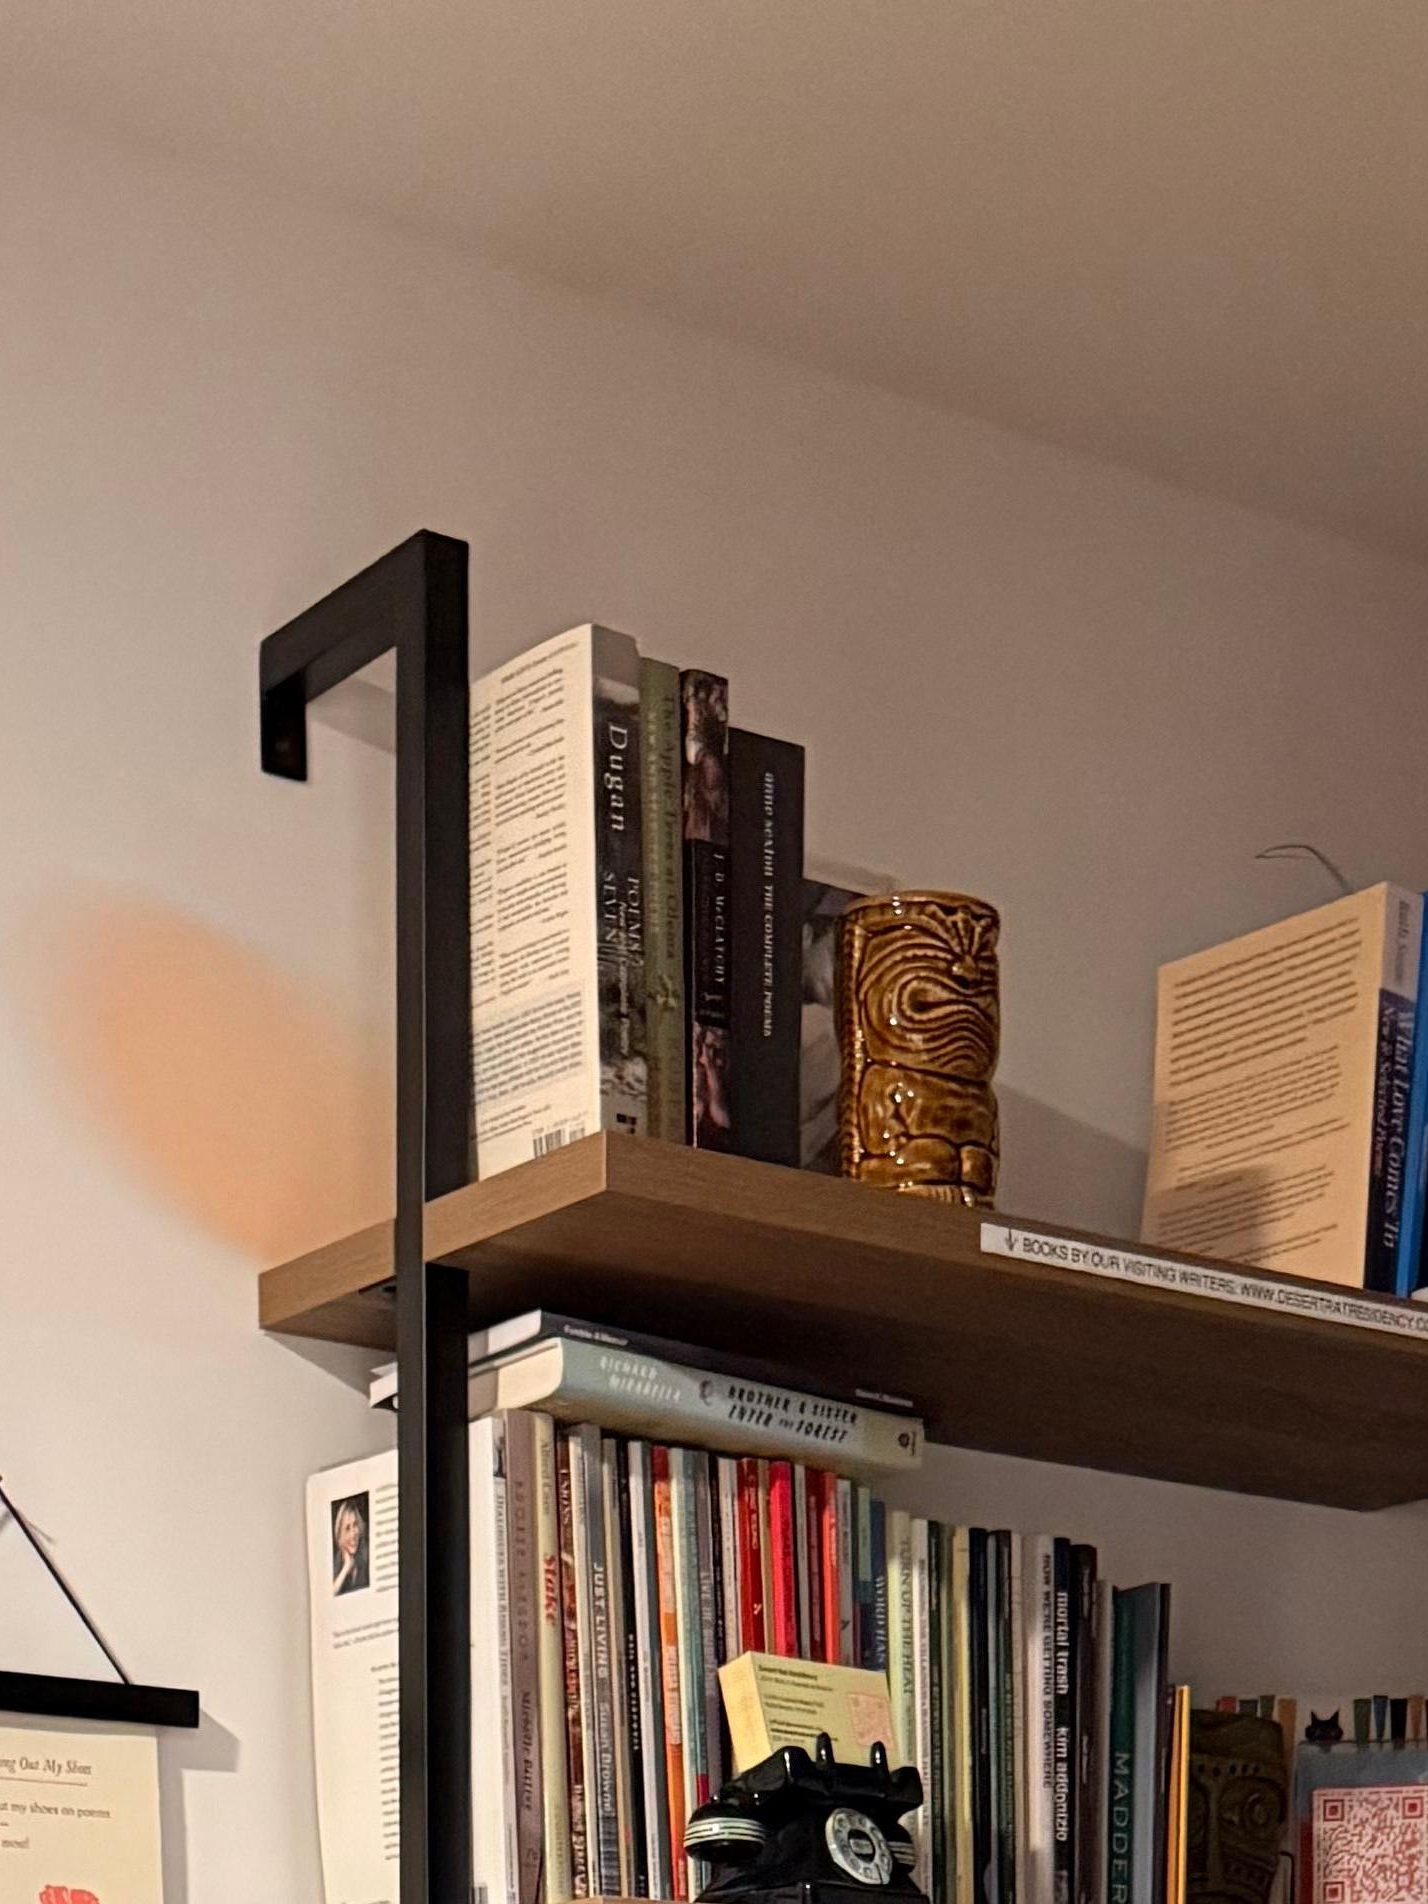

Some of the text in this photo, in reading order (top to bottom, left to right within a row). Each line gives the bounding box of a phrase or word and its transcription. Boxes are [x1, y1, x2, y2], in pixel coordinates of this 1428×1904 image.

[604, 724, 628, 831] Dugan
[763, 772, 775, 816] anne
[763, 885, 773, 911] THE
[1392, 1010, 1413, 1074] What
[1391, 1083, 1411, 1131] Love
[1385, 1137, 1407, 1216] Comes
[1022, 1238, 1068, 1261] BOOKS
[1072, 1248, 1089, 1264] BY
[1091, 1252, 1120, 1271] OUR
[1122, 1258, 1176, 1283] VISITING
[728, 1385, 857, 1426] BROTHER & SISTER
[729, 1404, 848, 1443] ENTER FOREST
[542, 1553, 559, 1627] Stake
[592, 1563, 615, 1812] JUST LIVING Susan Browne
[1054, 1592, 1070, 1841] mortal trash kim addonizio
[43, 1759, 62, 1776] My
[1111, 1751, 1131, 1904] MADDER
